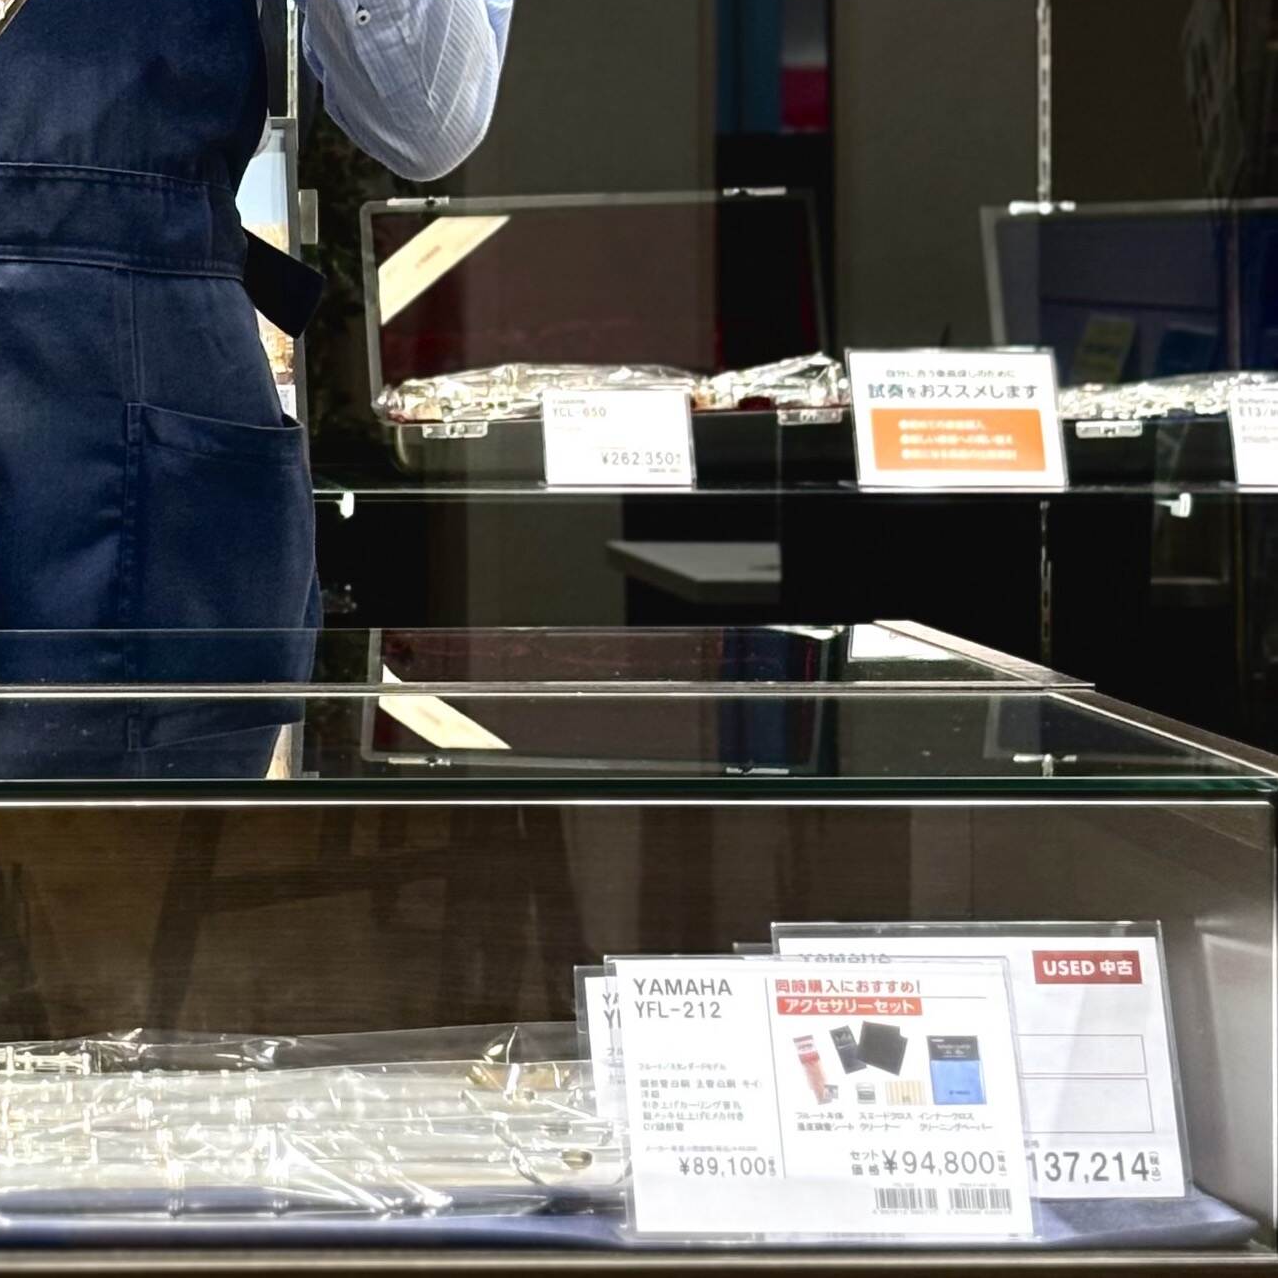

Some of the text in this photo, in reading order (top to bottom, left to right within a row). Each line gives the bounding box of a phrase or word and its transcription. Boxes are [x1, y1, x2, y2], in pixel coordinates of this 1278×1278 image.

[867, 382, 1039, 400] 試奏をおススメします
[1042, 959, 1134, 976] USED 中古
[633, 978, 733, 996] YAMAHA
[775, 978, 921, 995] 同時購入におすすめ!
[634, 1001, 722, 1019] YFL-212
[785, 997, 915, 1014] アクセサリーセット
[850, 1150, 879, 1160] セット
[882, 1150, 995, 1175] ¥94,800
[679, 1156, 767, 1177] ¥89,100
[1026, 1152, 1150, 1183] 137,214
